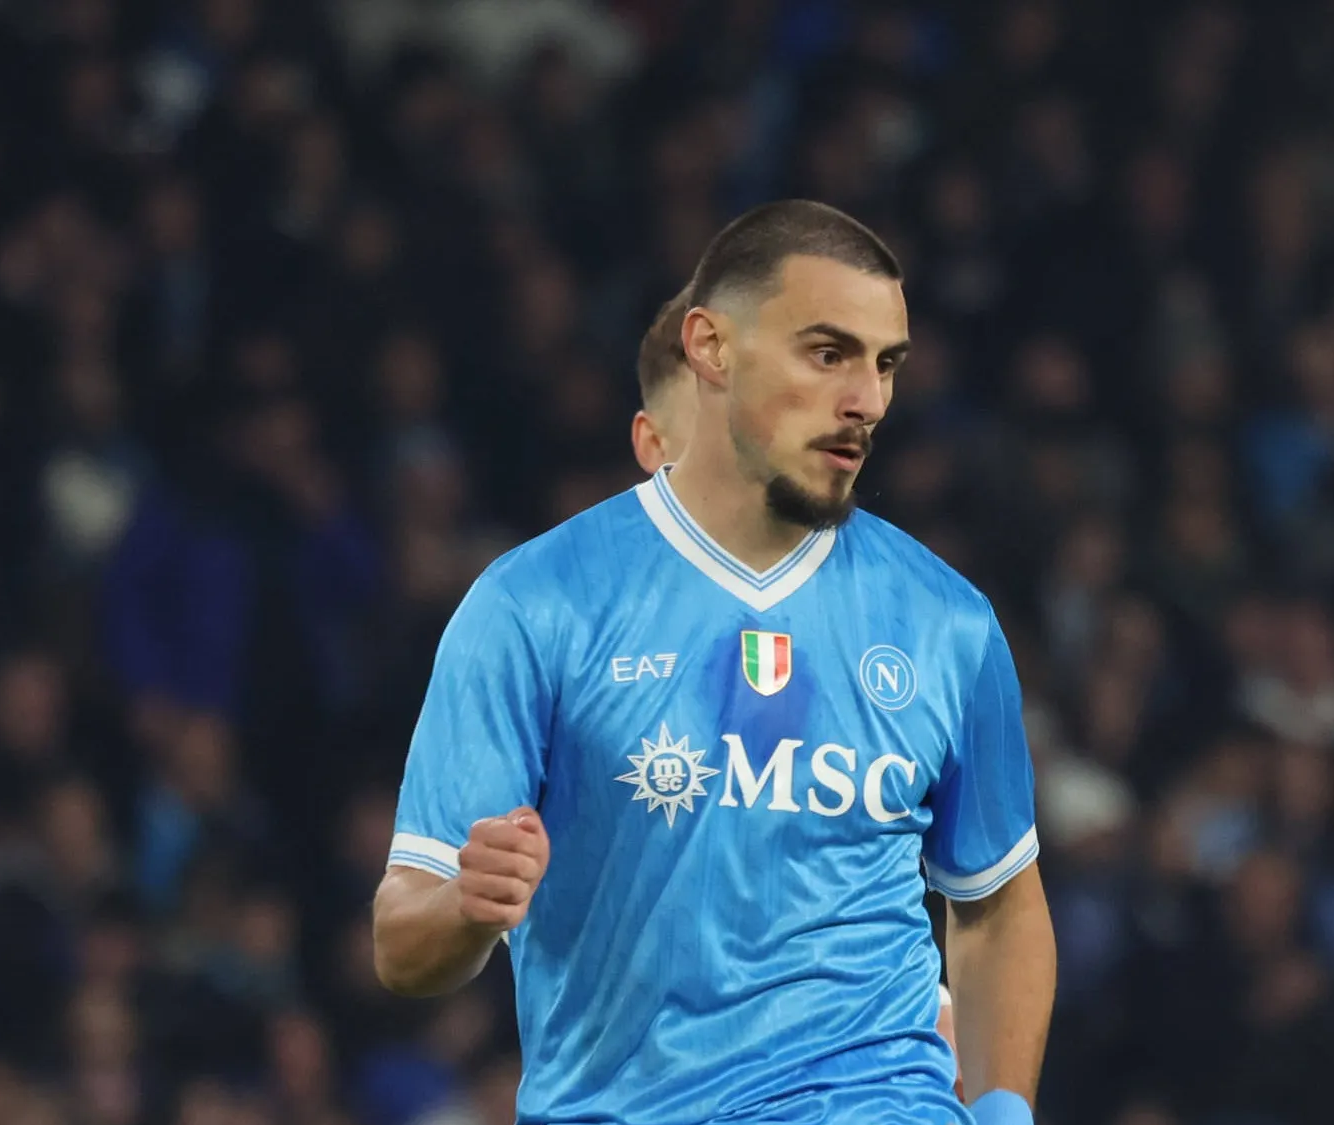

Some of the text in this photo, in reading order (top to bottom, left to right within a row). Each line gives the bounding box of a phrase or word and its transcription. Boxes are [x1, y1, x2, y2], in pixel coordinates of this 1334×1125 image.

[611, 653, 678, 682] EA7
[874, 662, 900, 693] N
[718, 733, 916, 823] MSC
